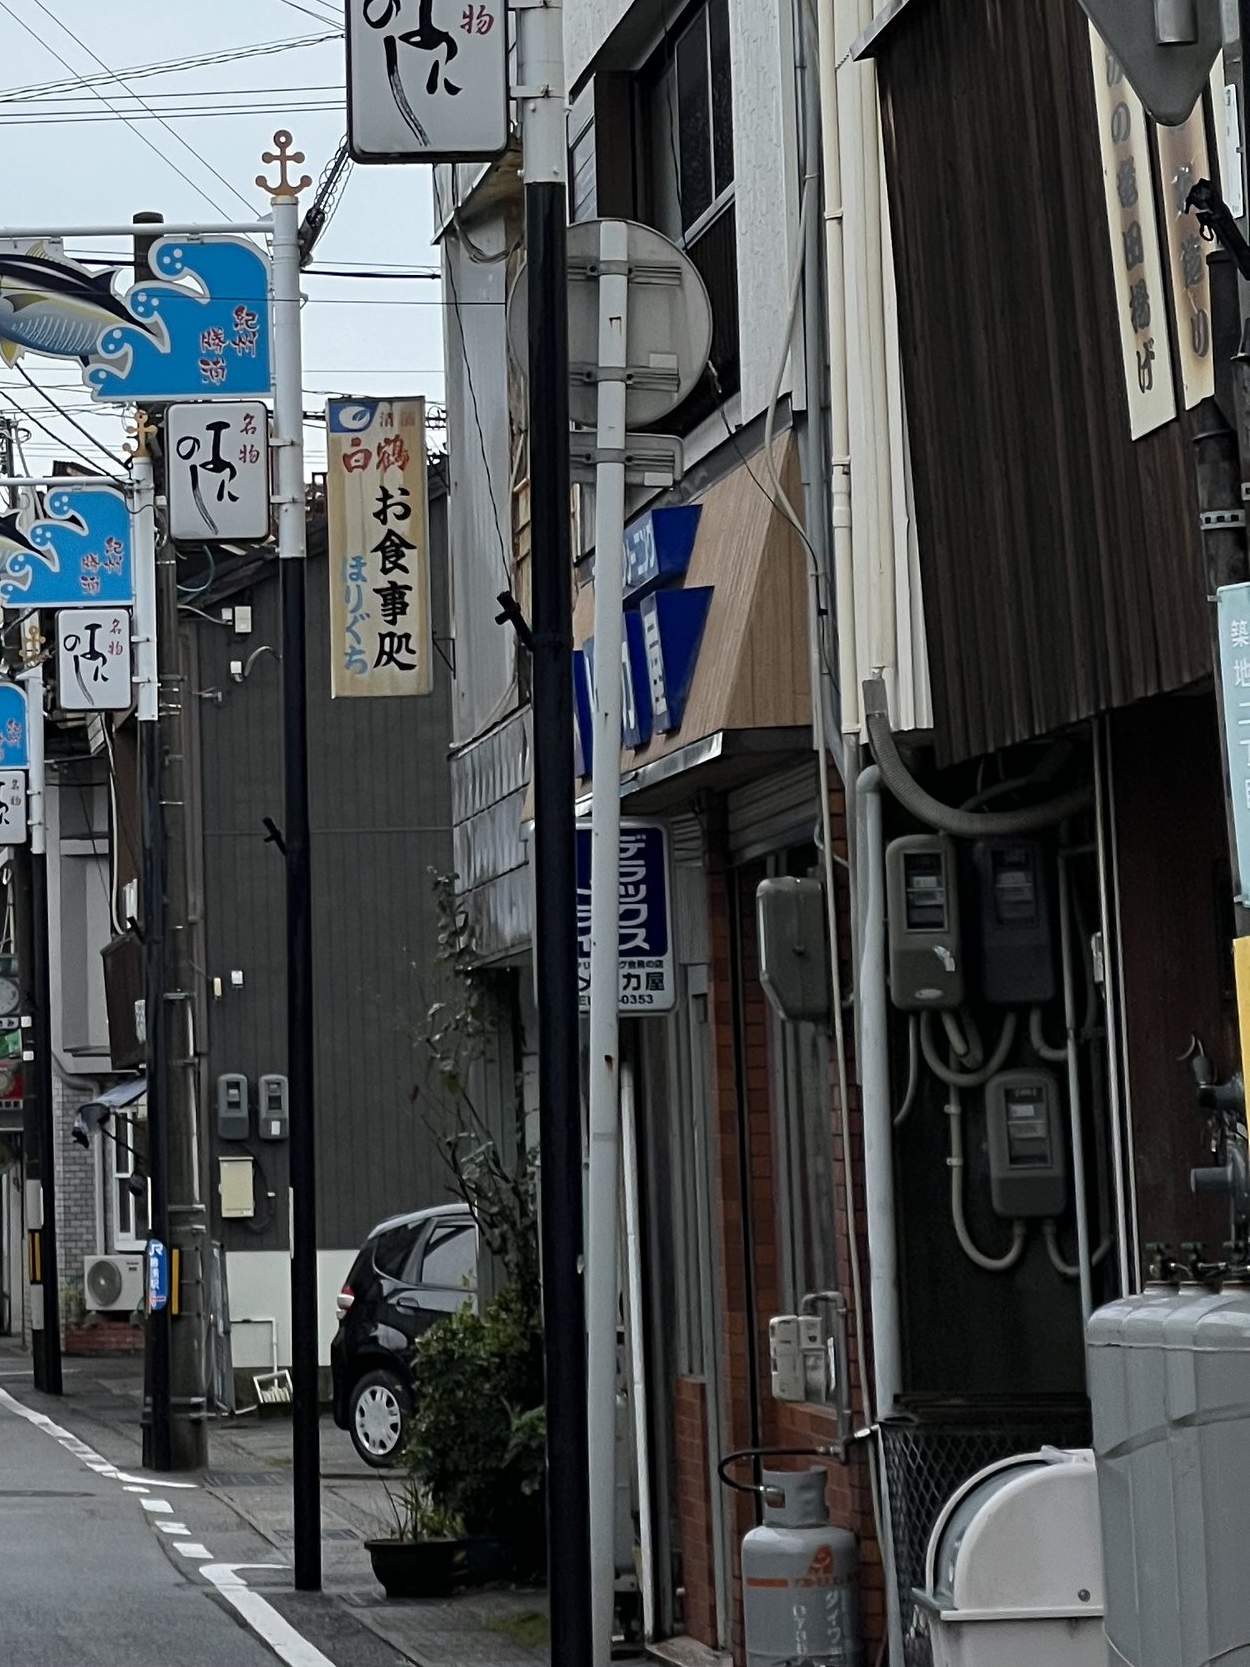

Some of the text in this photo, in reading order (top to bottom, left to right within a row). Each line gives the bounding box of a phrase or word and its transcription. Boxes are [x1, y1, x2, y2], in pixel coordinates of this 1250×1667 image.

[198, 326, 228, 385] 勝浦
[230, 304, 259, 358] 紀州
[239, 413, 260, 464] 名物
[342, 434, 410, 473] 白鶴
[370, 485, 417, 670] お食事処
[108, 619, 123, 655] 名物
[342, 555, 370, 675] ほりぐち
